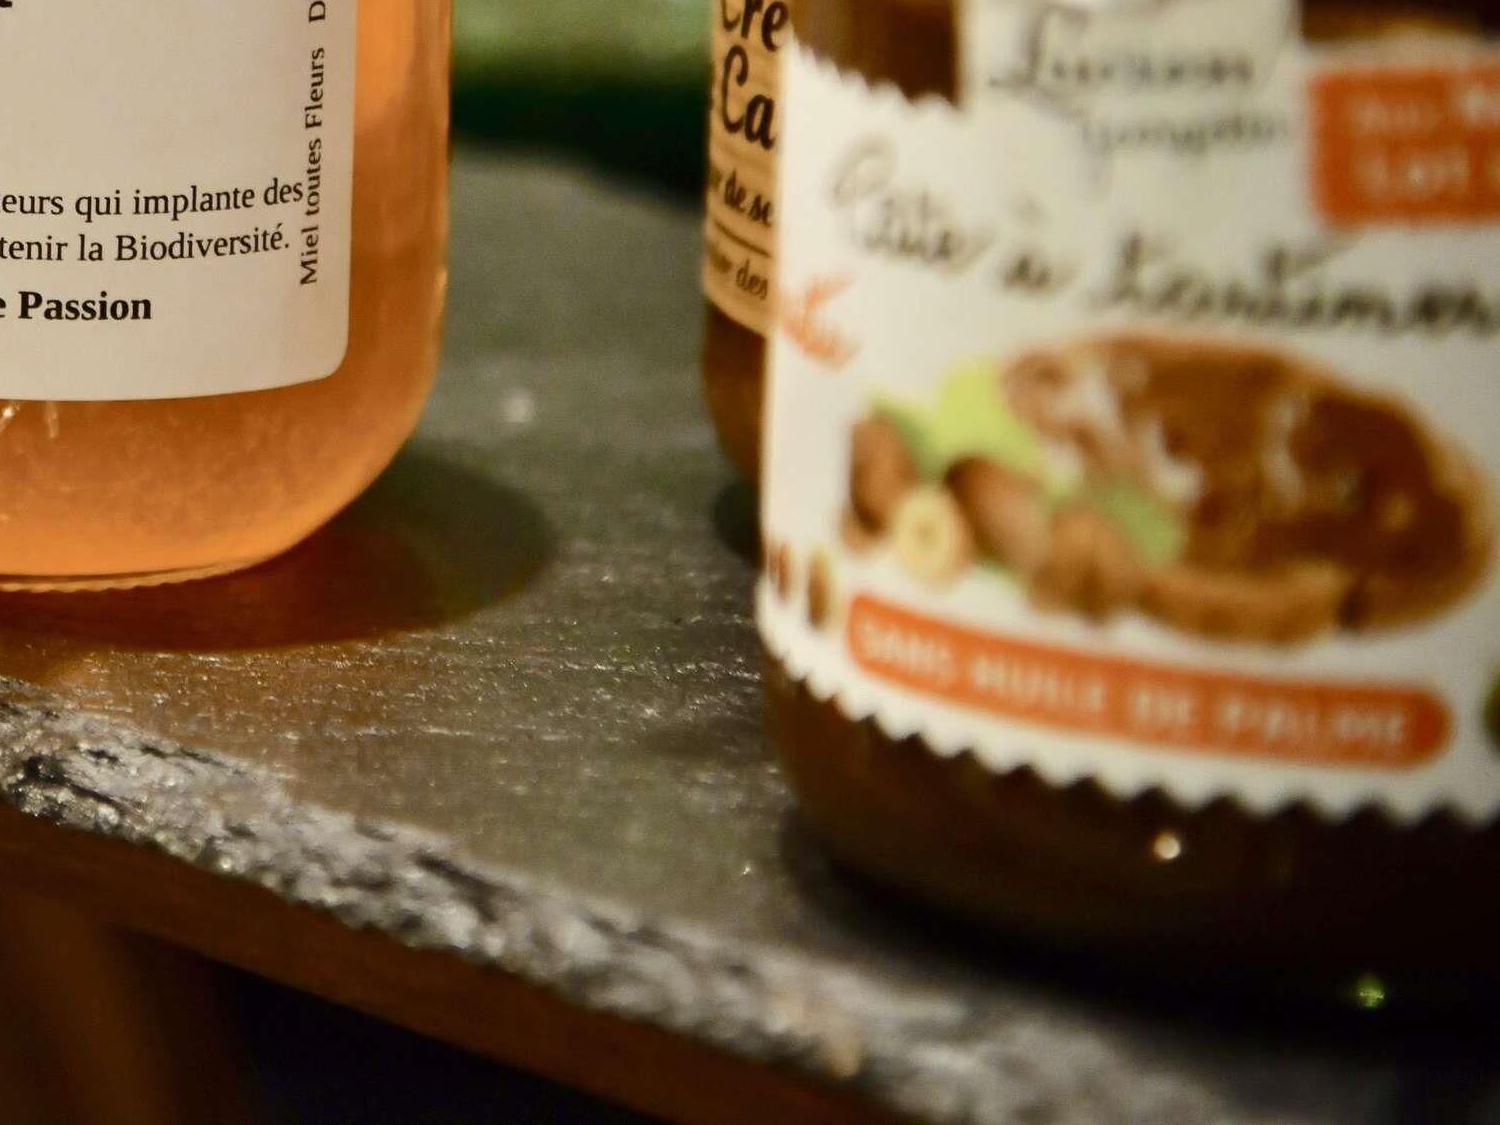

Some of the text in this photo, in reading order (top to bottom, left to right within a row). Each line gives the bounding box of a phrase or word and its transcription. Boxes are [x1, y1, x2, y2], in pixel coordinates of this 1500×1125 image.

[304, 47, 325, 130] Fleurs
[75, 190, 121, 223] qui
[133, 184, 254, 221] implante
[264, 177, 303, 205] des
[303, 137, 323, 217] toutes
[78, 233, 103, 262] la
[116, 223, 290, 262] Biodiversité.
[299, 224, 320, 285] Miel
[18, 290, 152, 321] Passion
